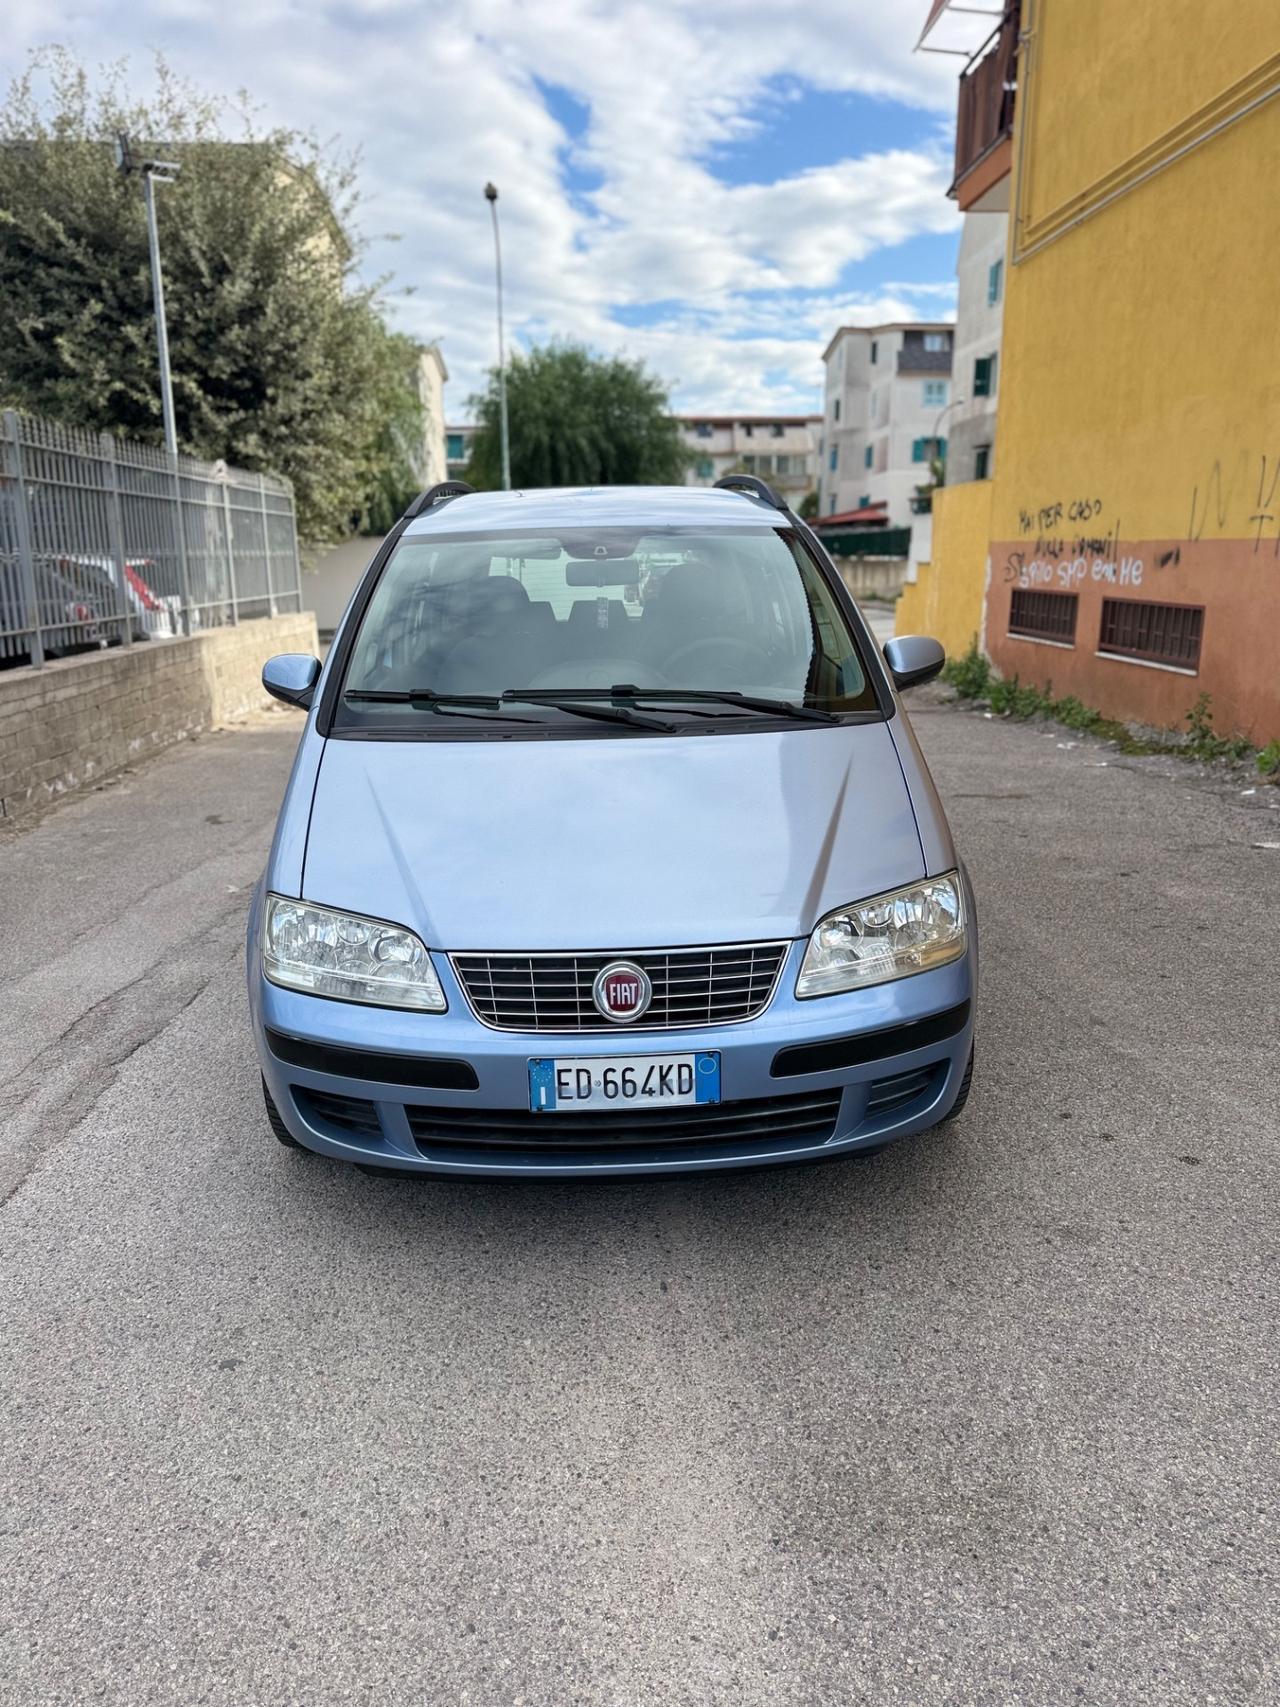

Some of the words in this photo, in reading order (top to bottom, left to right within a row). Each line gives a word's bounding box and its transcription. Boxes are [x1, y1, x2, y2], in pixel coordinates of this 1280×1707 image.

[1038, 501, 1063, 531] PER
[1068, 498, 1102, 521] CASO
[609, 983, 638, 1005] FIAT
[556, 1068, 592, 1100] ED
[602, 1063, 693, 1099] 664KD
